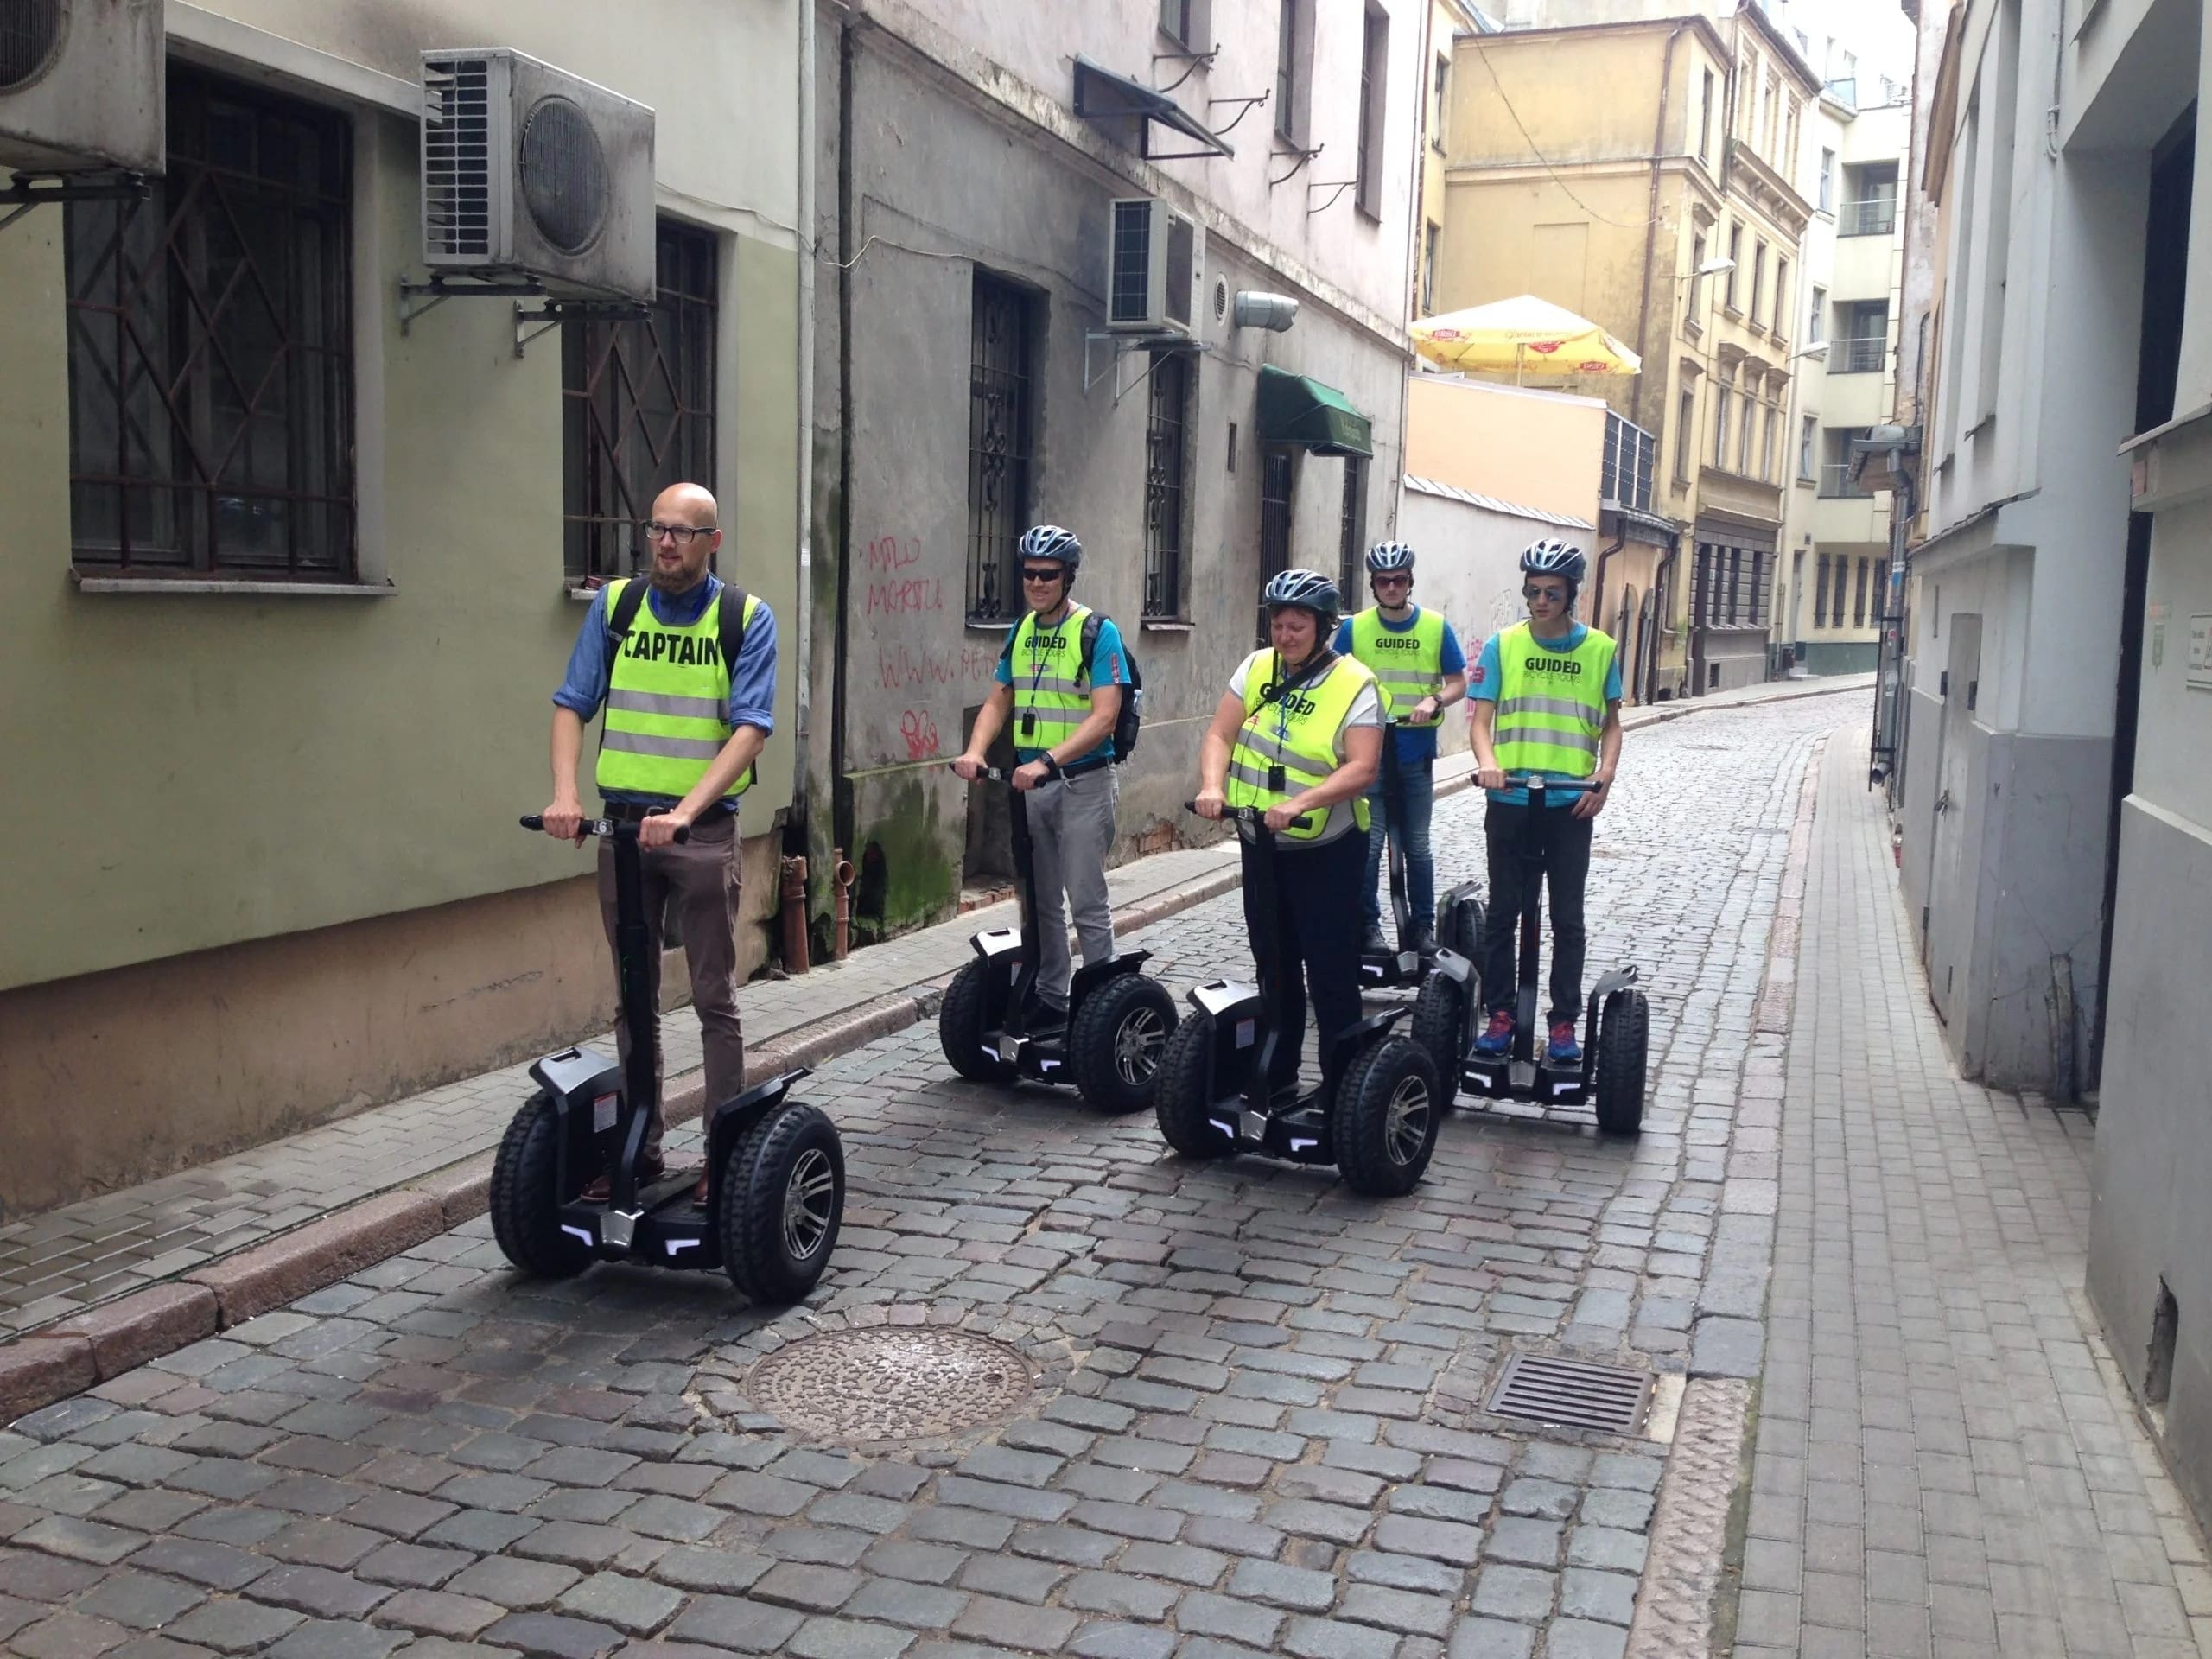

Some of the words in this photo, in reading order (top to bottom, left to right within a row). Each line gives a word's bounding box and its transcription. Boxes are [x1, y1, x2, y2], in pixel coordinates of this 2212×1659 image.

[624, 630, 720, 666] CAPTAIN
[1024, 635, 1067, 650] GUIDED
[1376, 638, 1421, 650] GUIDED
[1524, 657, 1582, 675] GUIDED
[1523, 670, 1554, 681] BICYCLE
[1556, 673, 1584, 684] TOURS
[1260, 683, 1316, 716] GIDED
[599, 821, 607, 833] 6
